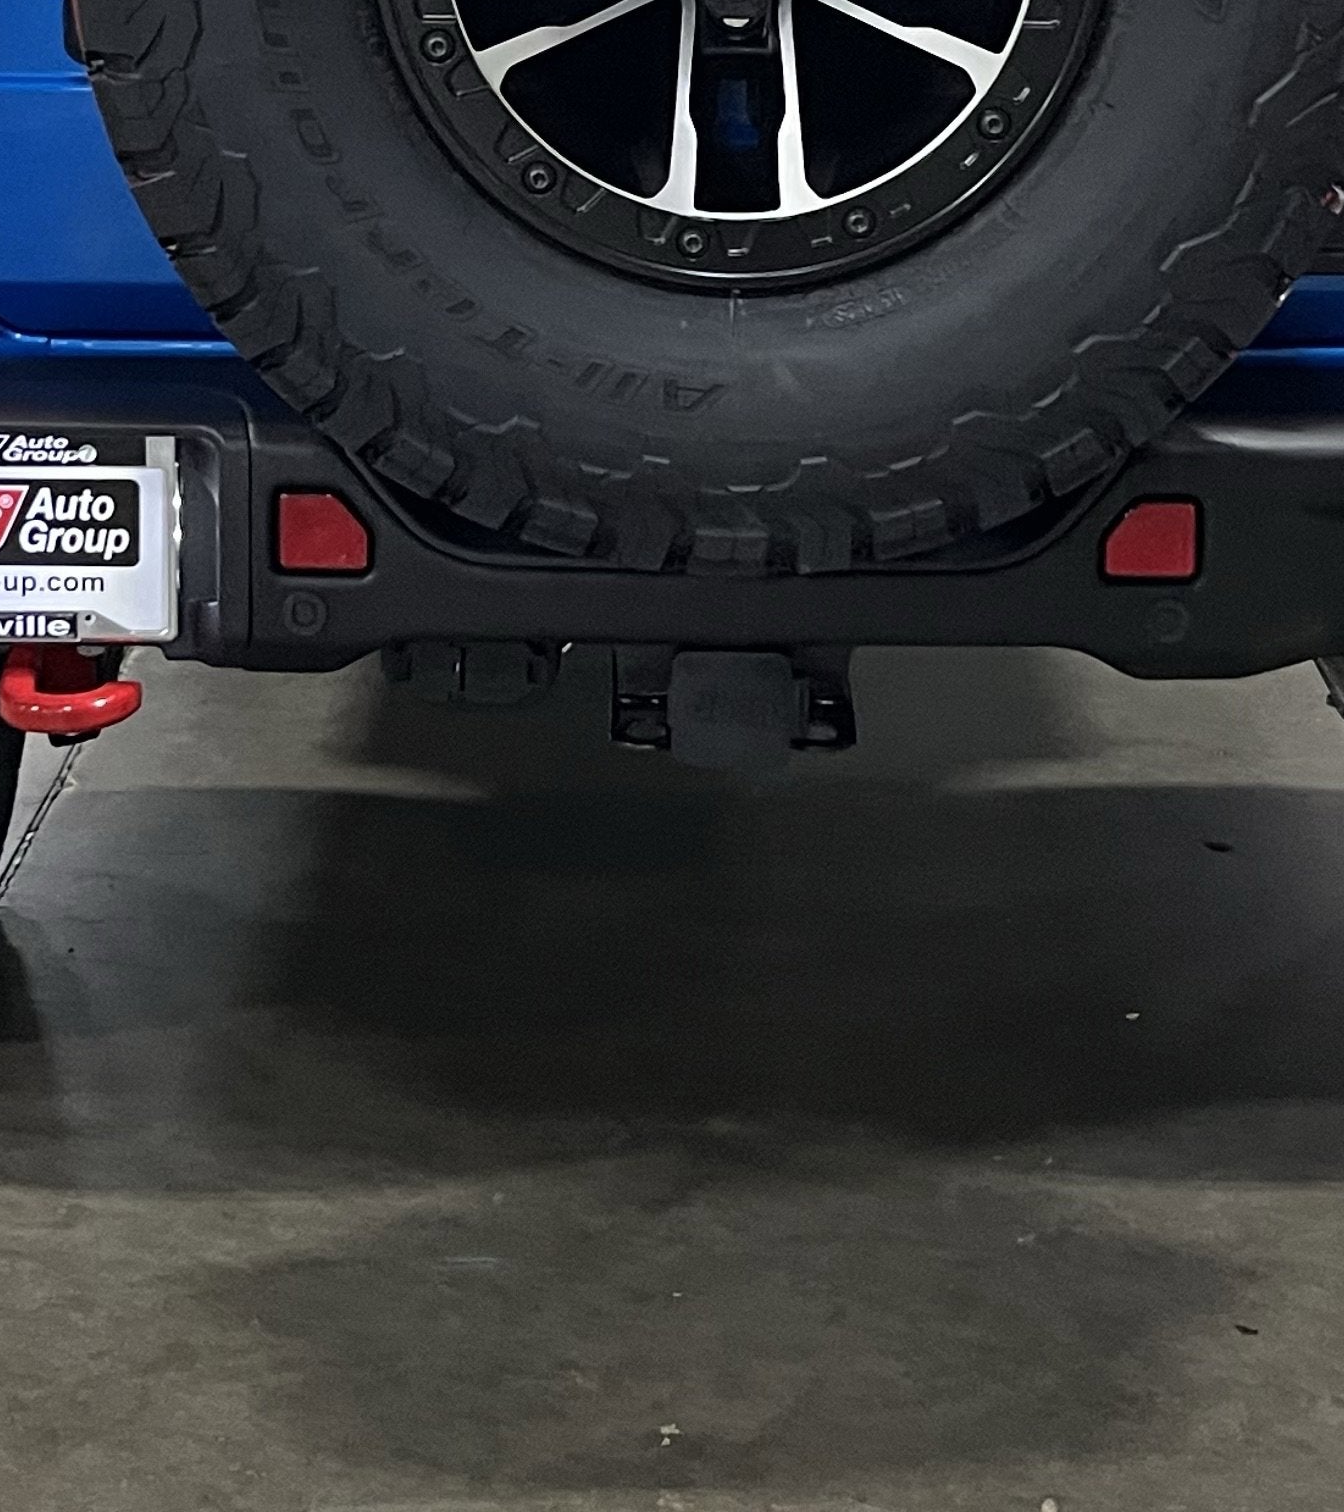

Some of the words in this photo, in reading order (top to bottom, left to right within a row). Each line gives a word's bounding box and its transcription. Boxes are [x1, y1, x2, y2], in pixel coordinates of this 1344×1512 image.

[8, 435, 69, 450] Auto
[26, 487, 115, 522] Auto
[18, 520, 130, 561] Group
